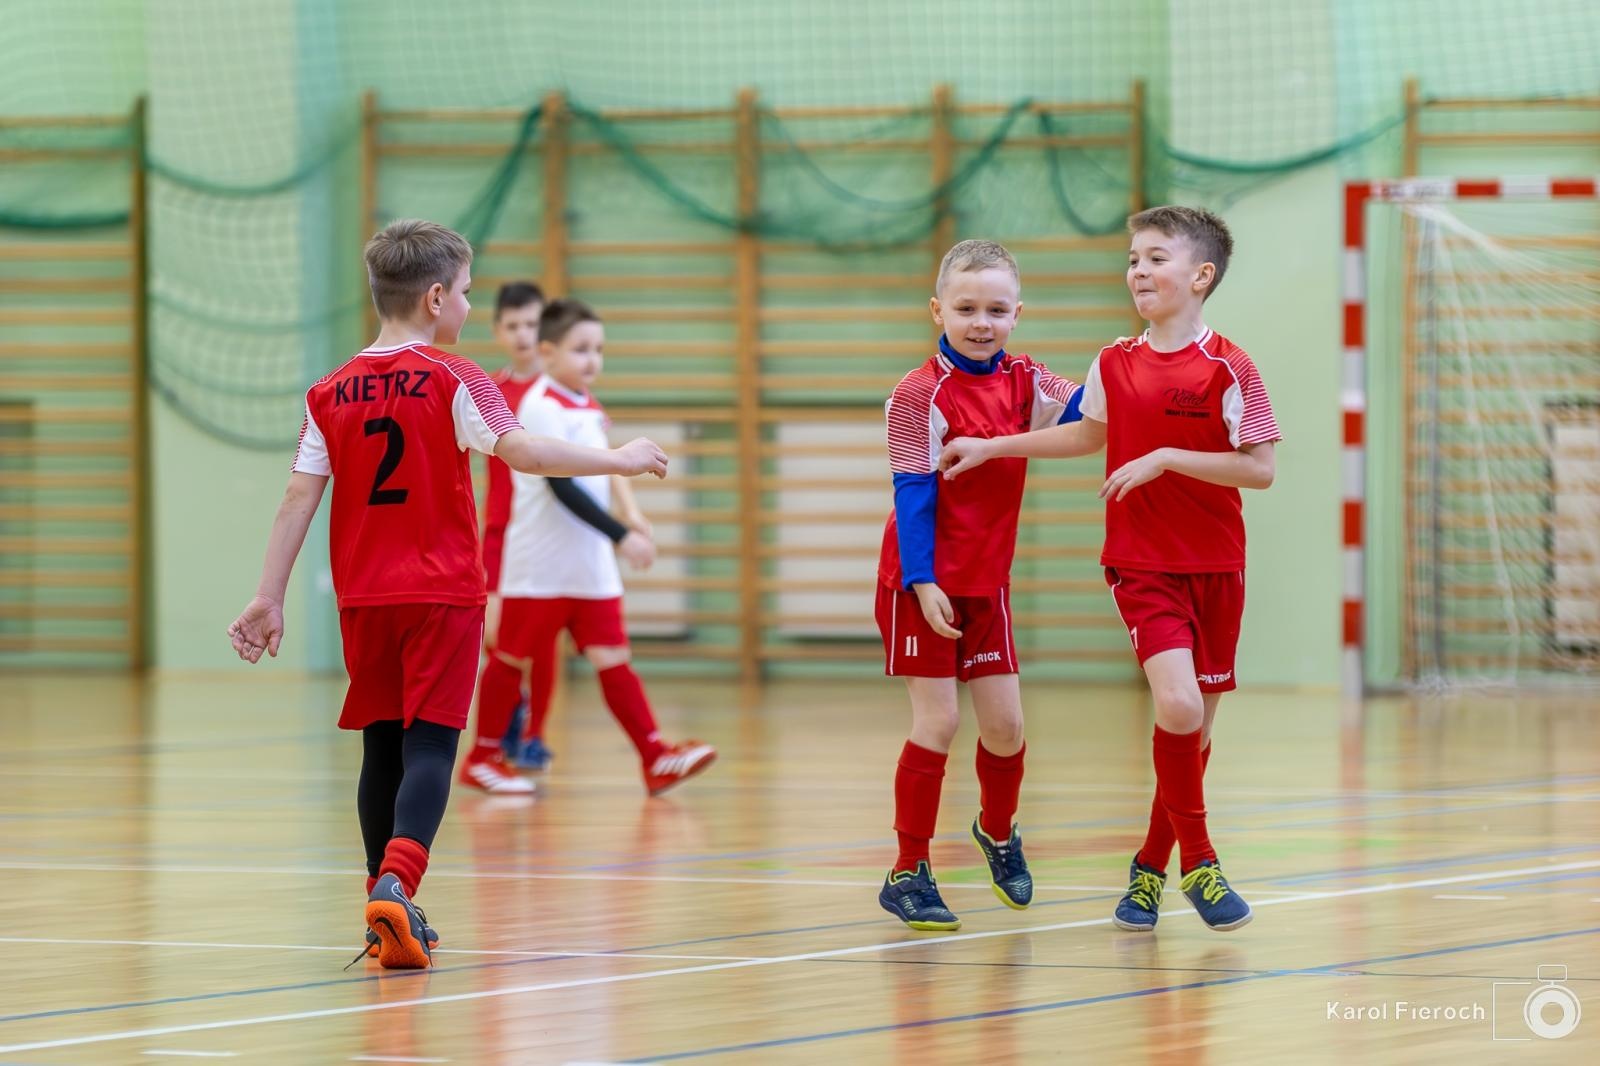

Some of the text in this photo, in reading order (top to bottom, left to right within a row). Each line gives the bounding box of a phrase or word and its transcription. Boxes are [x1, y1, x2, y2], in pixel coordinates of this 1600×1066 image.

[335, 370, 431, 406] KIETRZ
[363, 416, 409, 506] 2
[905, 635, 918, 657] 11
